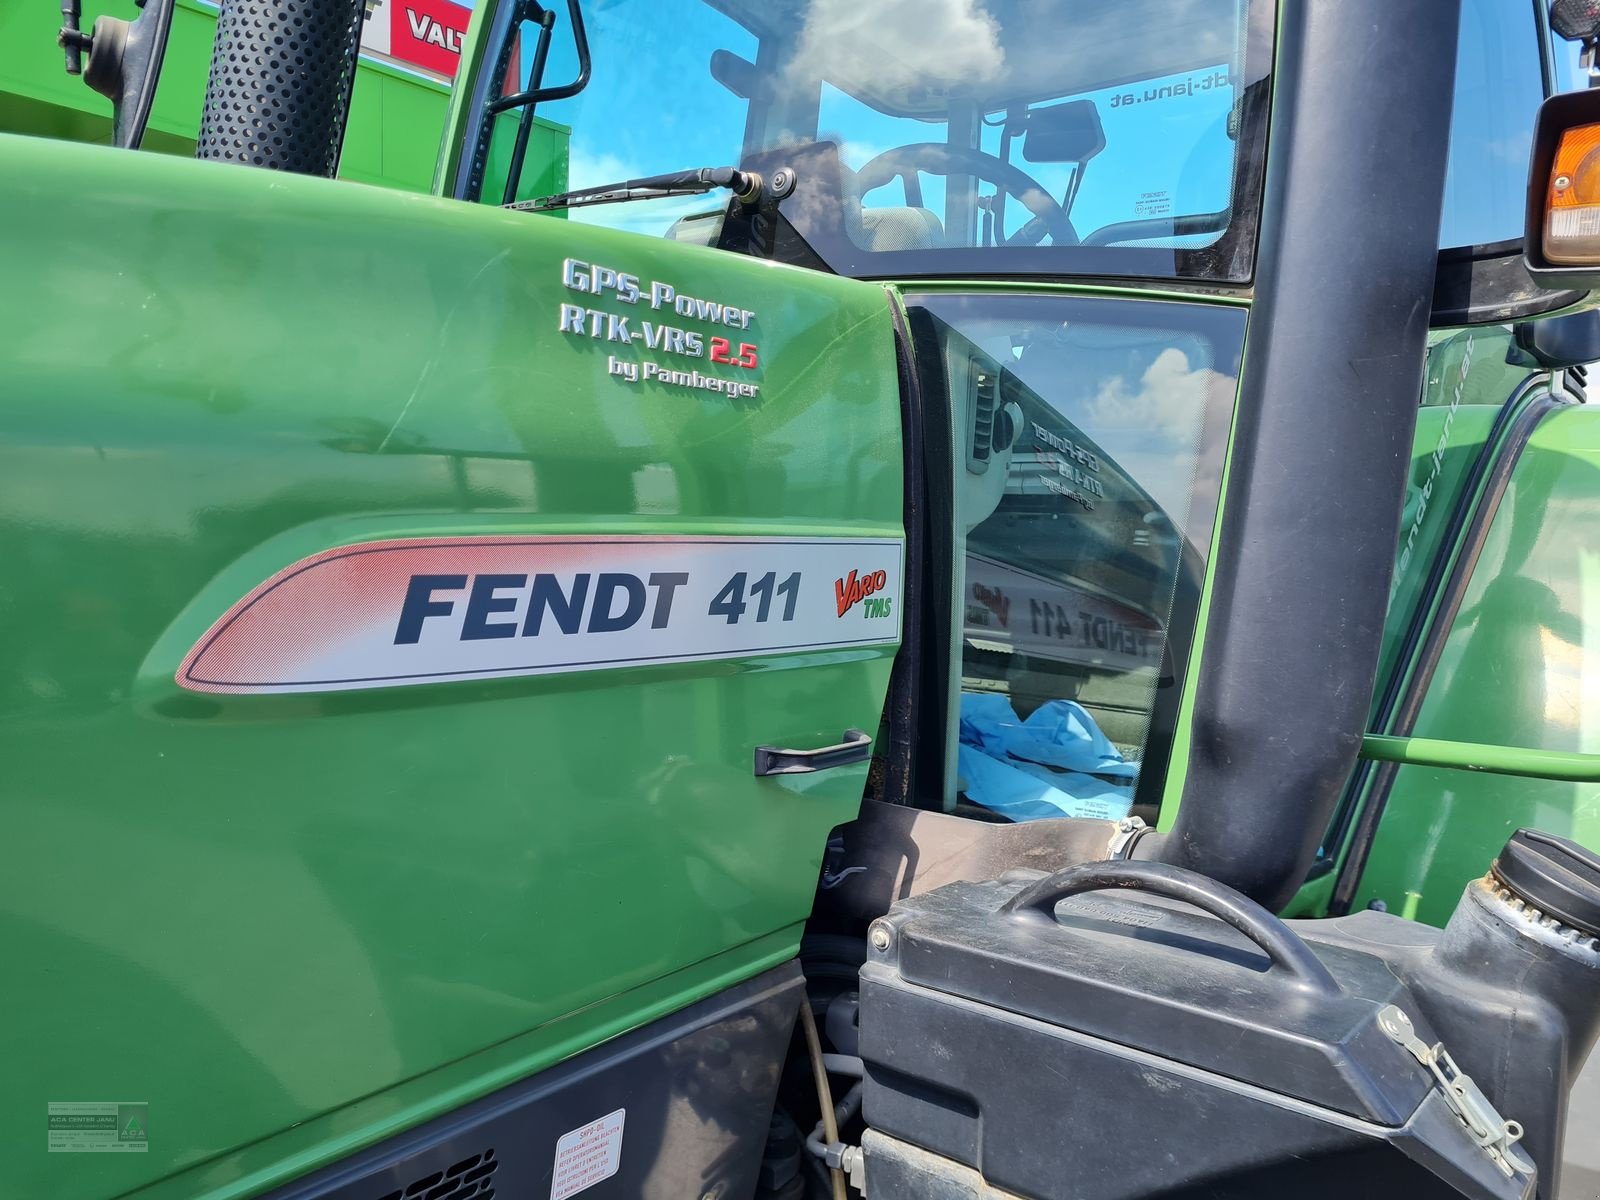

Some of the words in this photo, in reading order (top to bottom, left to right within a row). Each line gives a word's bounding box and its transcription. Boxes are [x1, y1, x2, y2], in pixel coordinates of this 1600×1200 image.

[562, 257, 756, 330] GPS-Power
[559, 302, 705, 358] RTK-VRS
[710, 336, 758, 369] 2.5
[608, 355, 639, 382] by
[642, 361, 760, 399] Pamberger
[392, 571, 690, 646] FENDT
[707, 570, 802, 625] 411
[835, 568, 887, 618] VARIO
[864, 597, 892, 619] TMS
